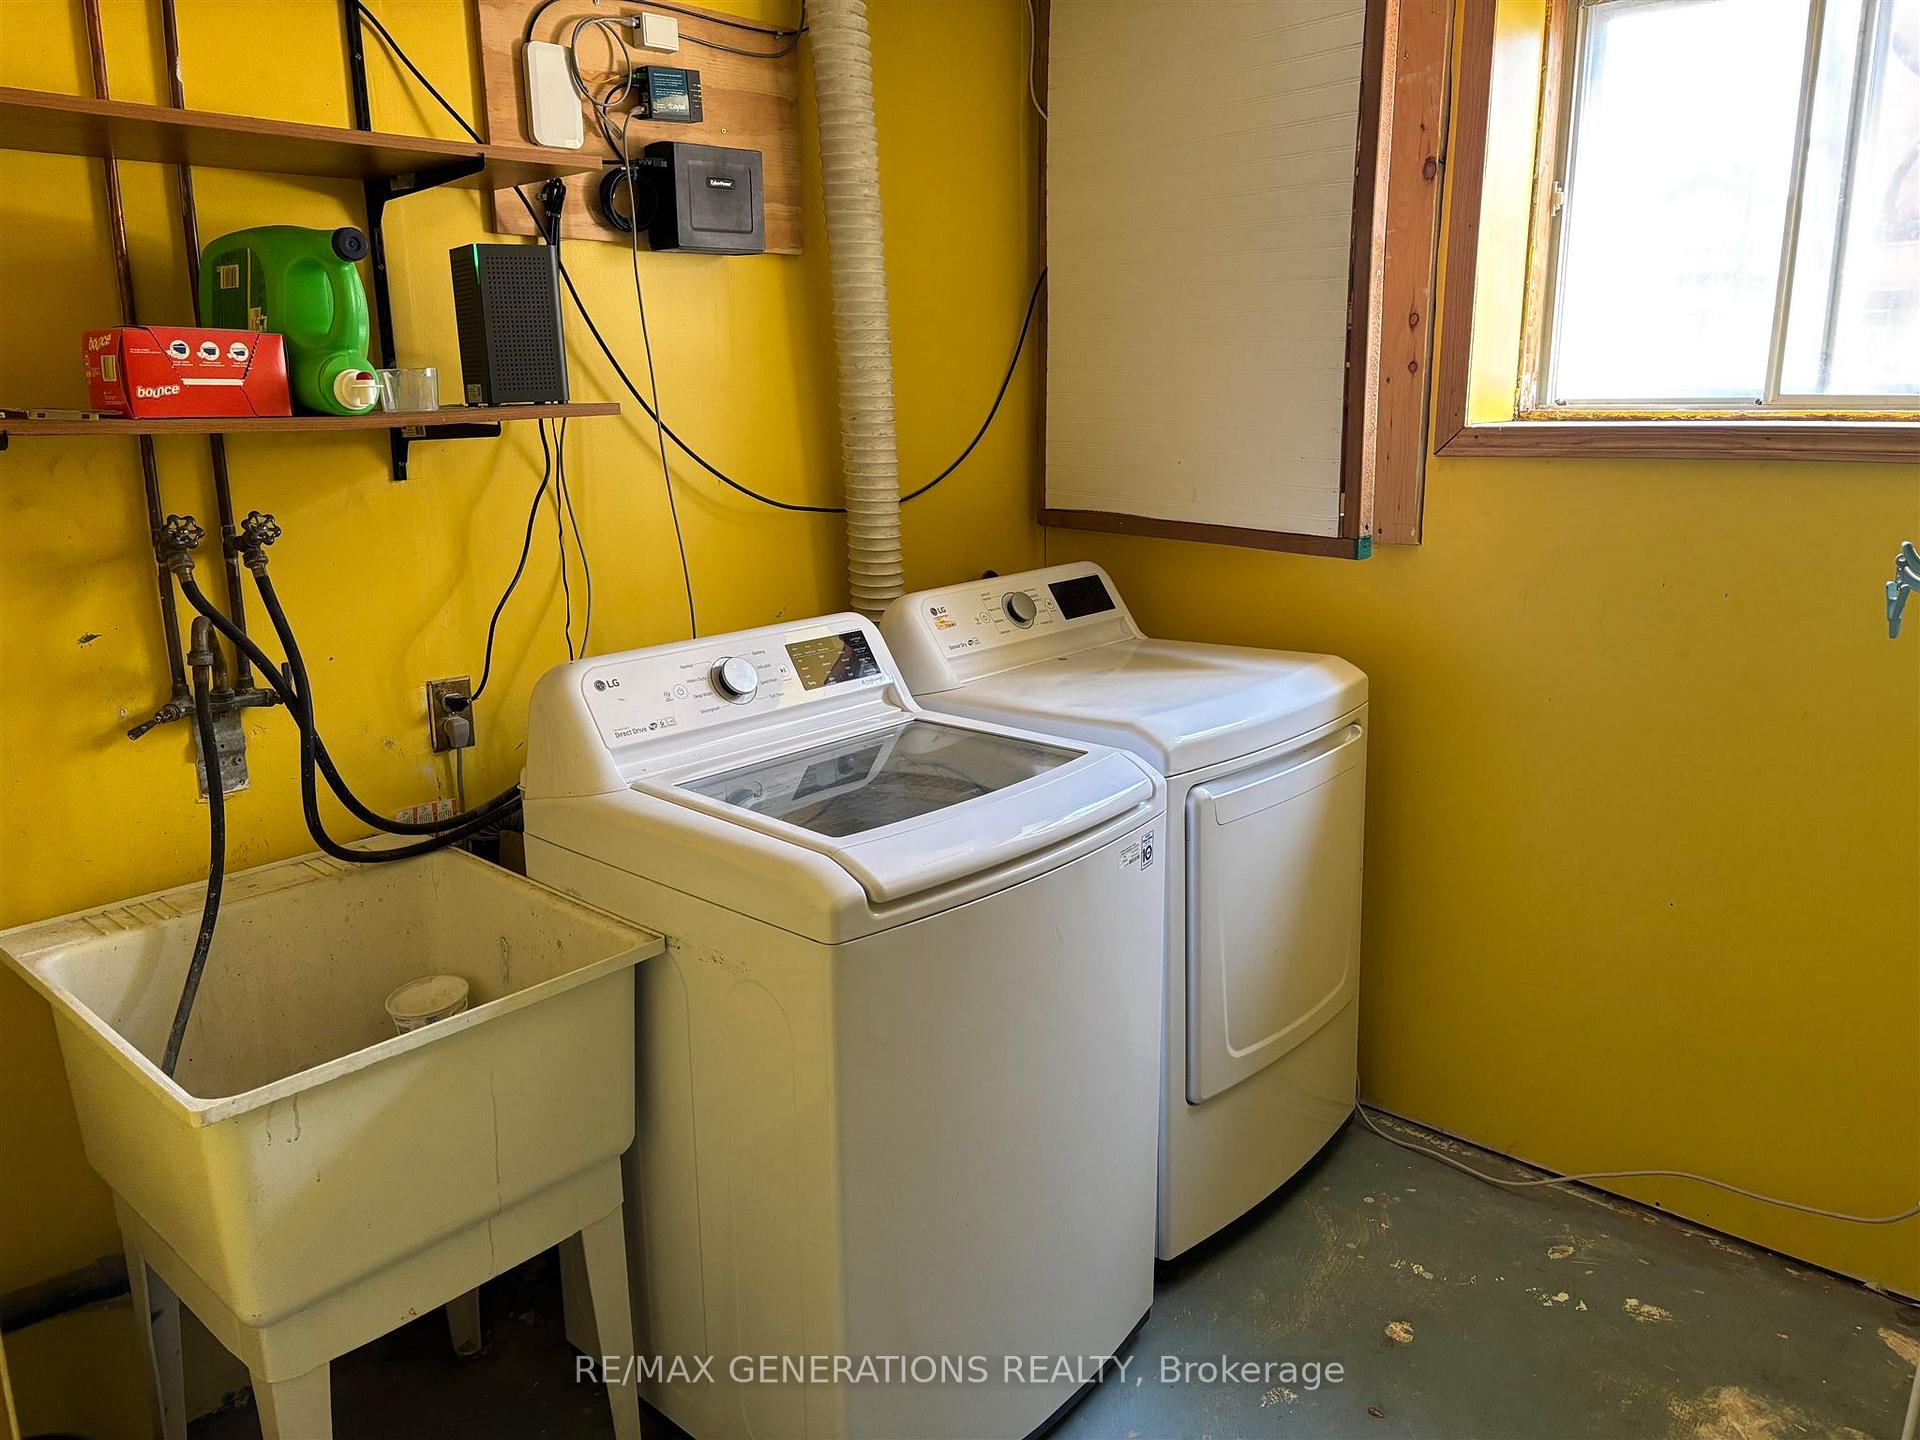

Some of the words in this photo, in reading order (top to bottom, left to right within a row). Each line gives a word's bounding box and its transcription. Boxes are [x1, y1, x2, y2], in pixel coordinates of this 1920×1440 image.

[136, 384, 180, 399] bounce
[606, 678, 620, 689] LG
[614, 729, 632, 739] Direct
[632, 726, 648, 735] Drive
